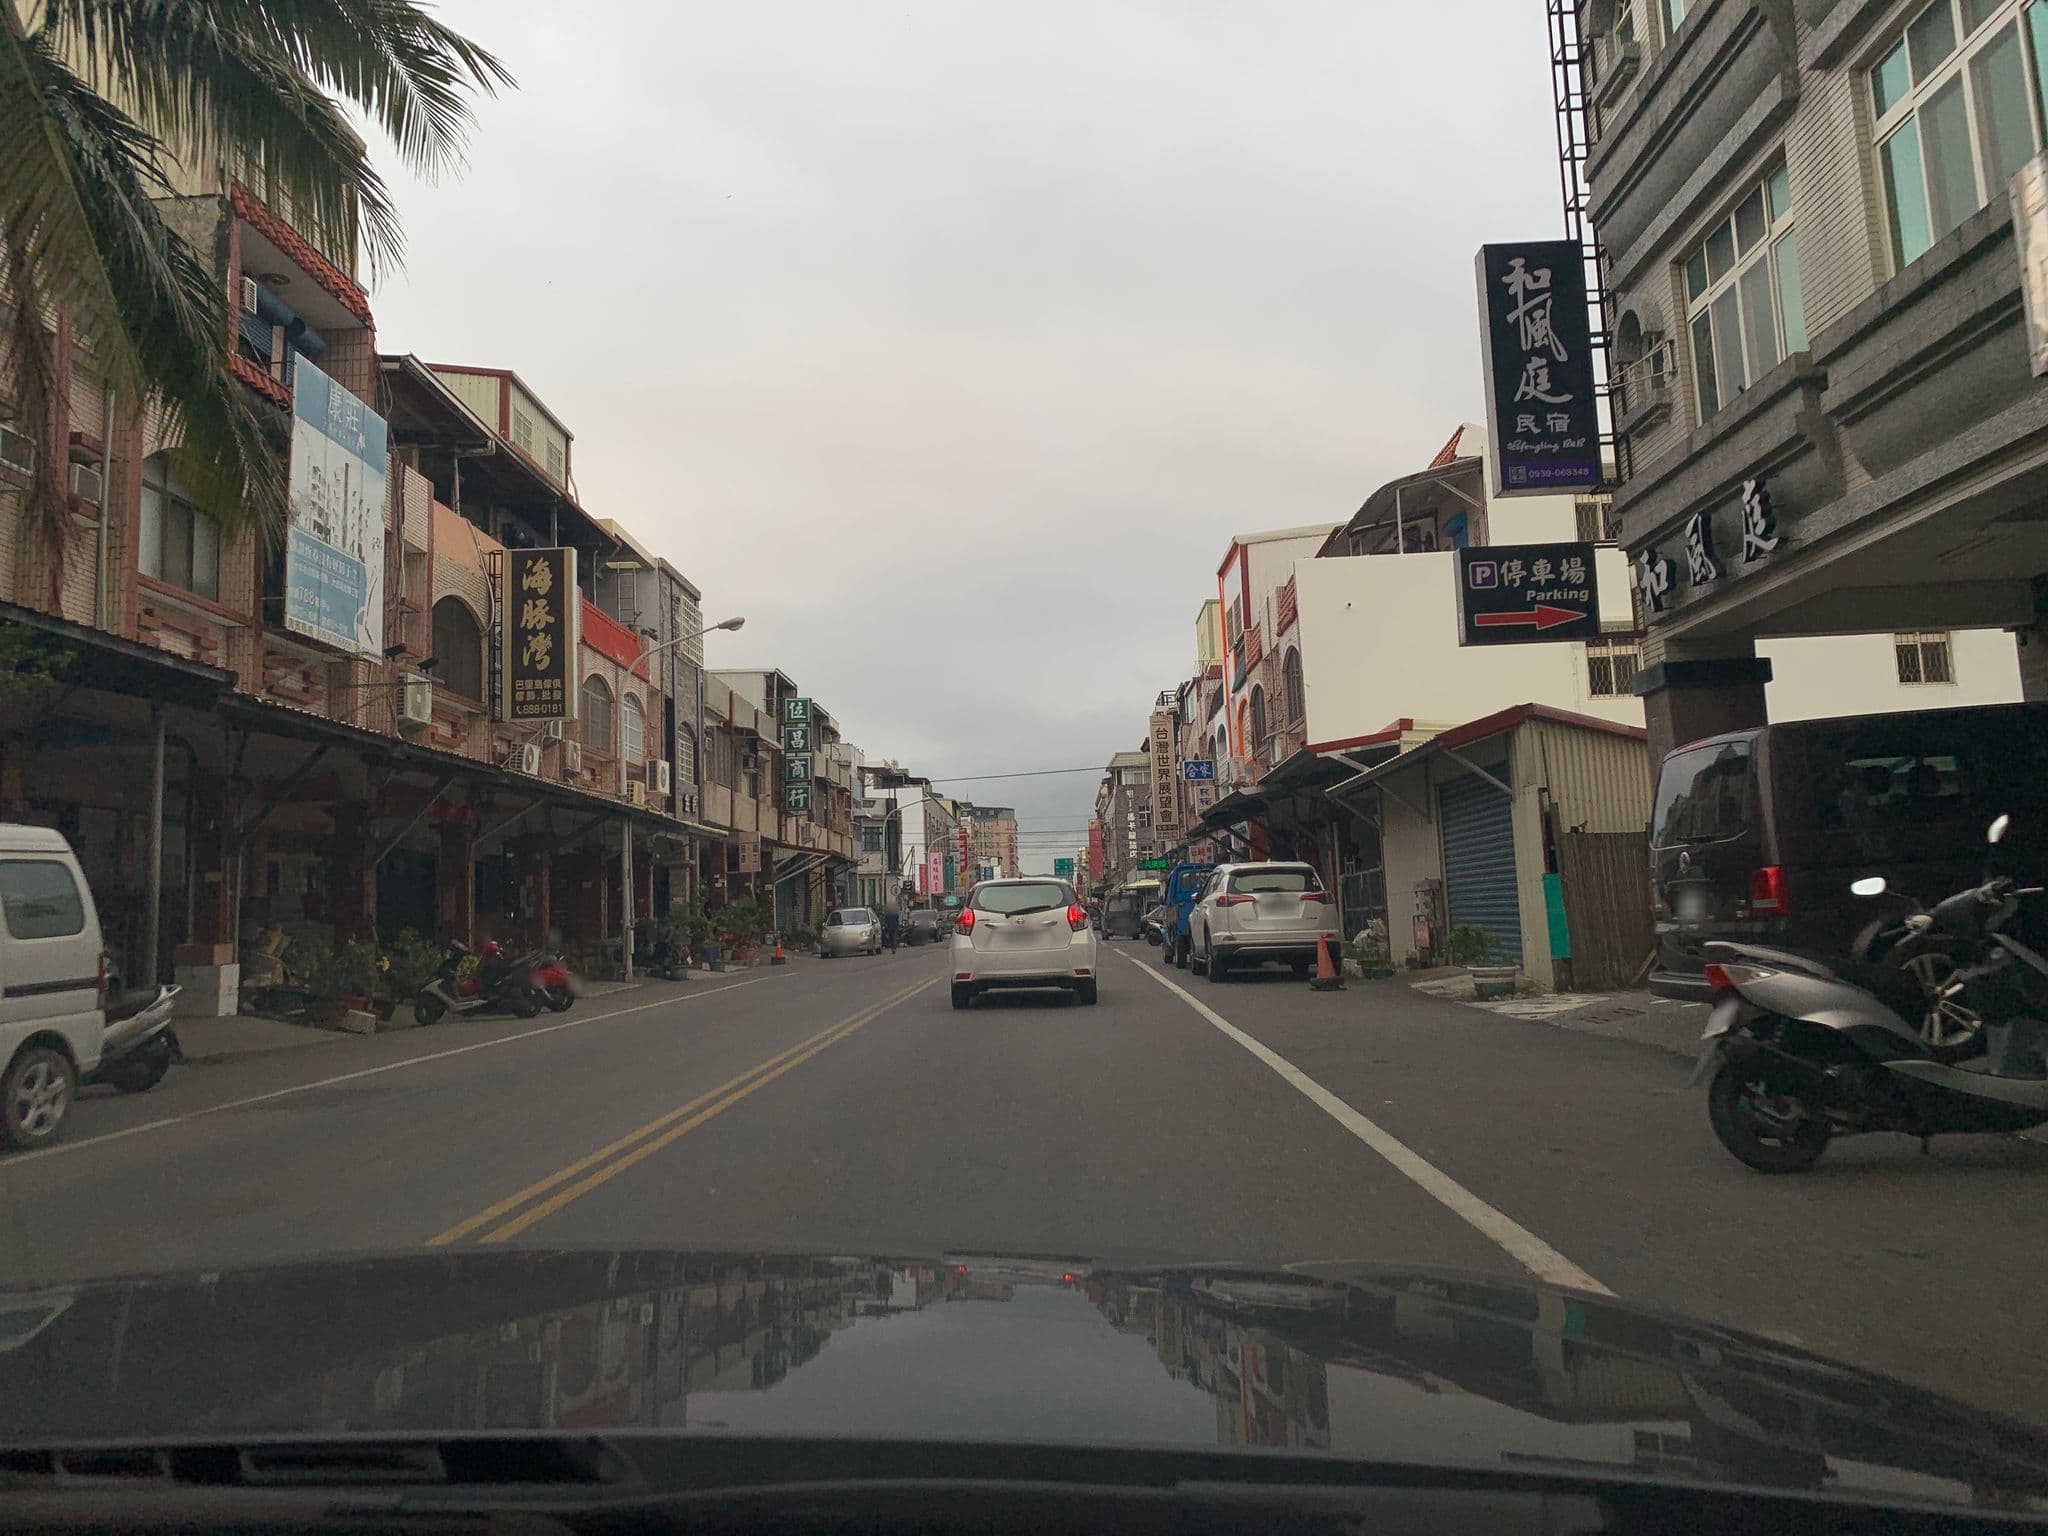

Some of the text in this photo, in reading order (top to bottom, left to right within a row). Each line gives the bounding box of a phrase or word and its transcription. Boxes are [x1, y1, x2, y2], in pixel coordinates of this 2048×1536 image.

[1501, 257, 1574, 404] 和風庭
[1515, 412, 1572, 434] 民宿
[1500, 556, 1587, 588] 停車場
[1526, 588, 1589, 602] Parking
[520, 557, 555, 671] 海豚灣
[1155, 727, 1173, 823] 台灣世界展望會
